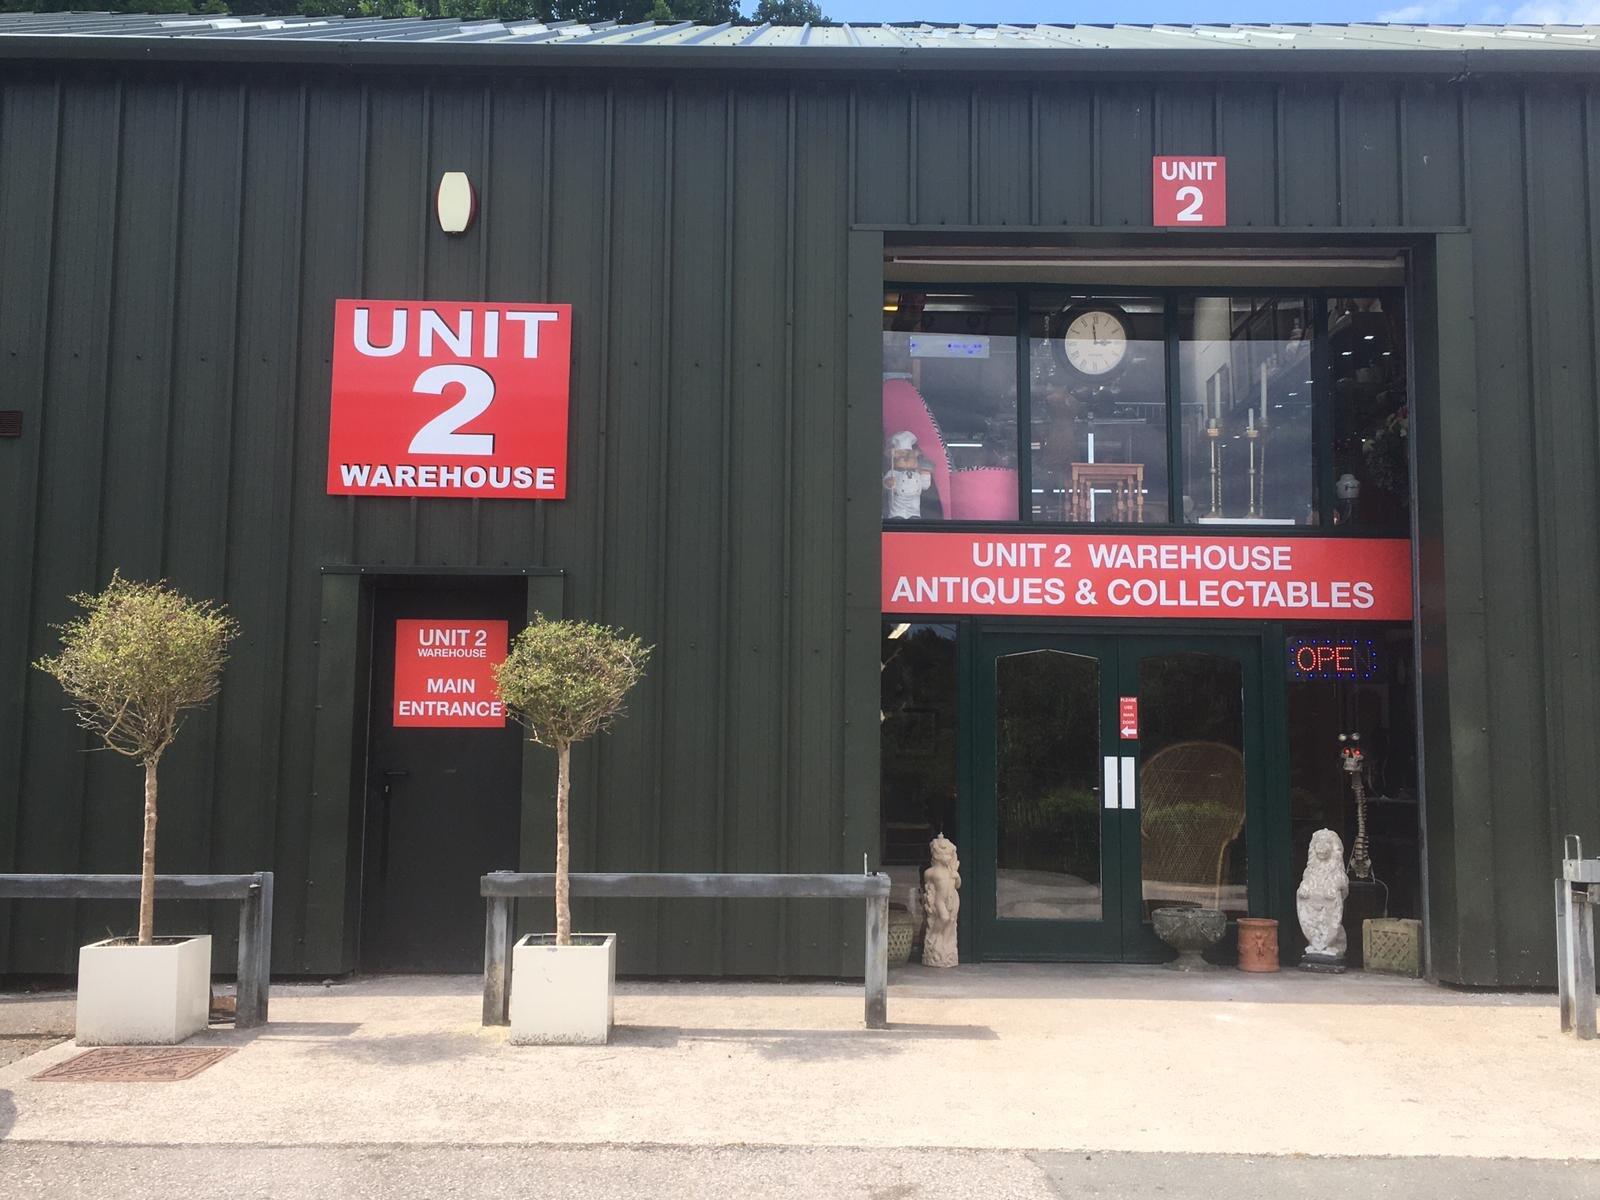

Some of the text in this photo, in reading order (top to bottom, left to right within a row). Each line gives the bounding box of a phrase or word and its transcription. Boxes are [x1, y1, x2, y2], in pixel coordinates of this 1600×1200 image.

[1161, 161, 1218, 181] UNIT
[1175, 186, 1204, 222] 2
[353, 308, 558, 359] UNIT
[407, 364, 495, 456] 2
[340, 464, 555, 490] WAREHOUSE
[972, 542, 1292, 571] UNIT 2 WAREHOUSE
[890, 576, 1375, 609] ANTIQUES & COLLECTABLES
[419, 629, 487, 647] UNIT 2
[417, 648, 487, 658] WAREHOUSE
[427, 678, 476, 694] MAIN
[399, 701, 502, 717] ENTRANCE
